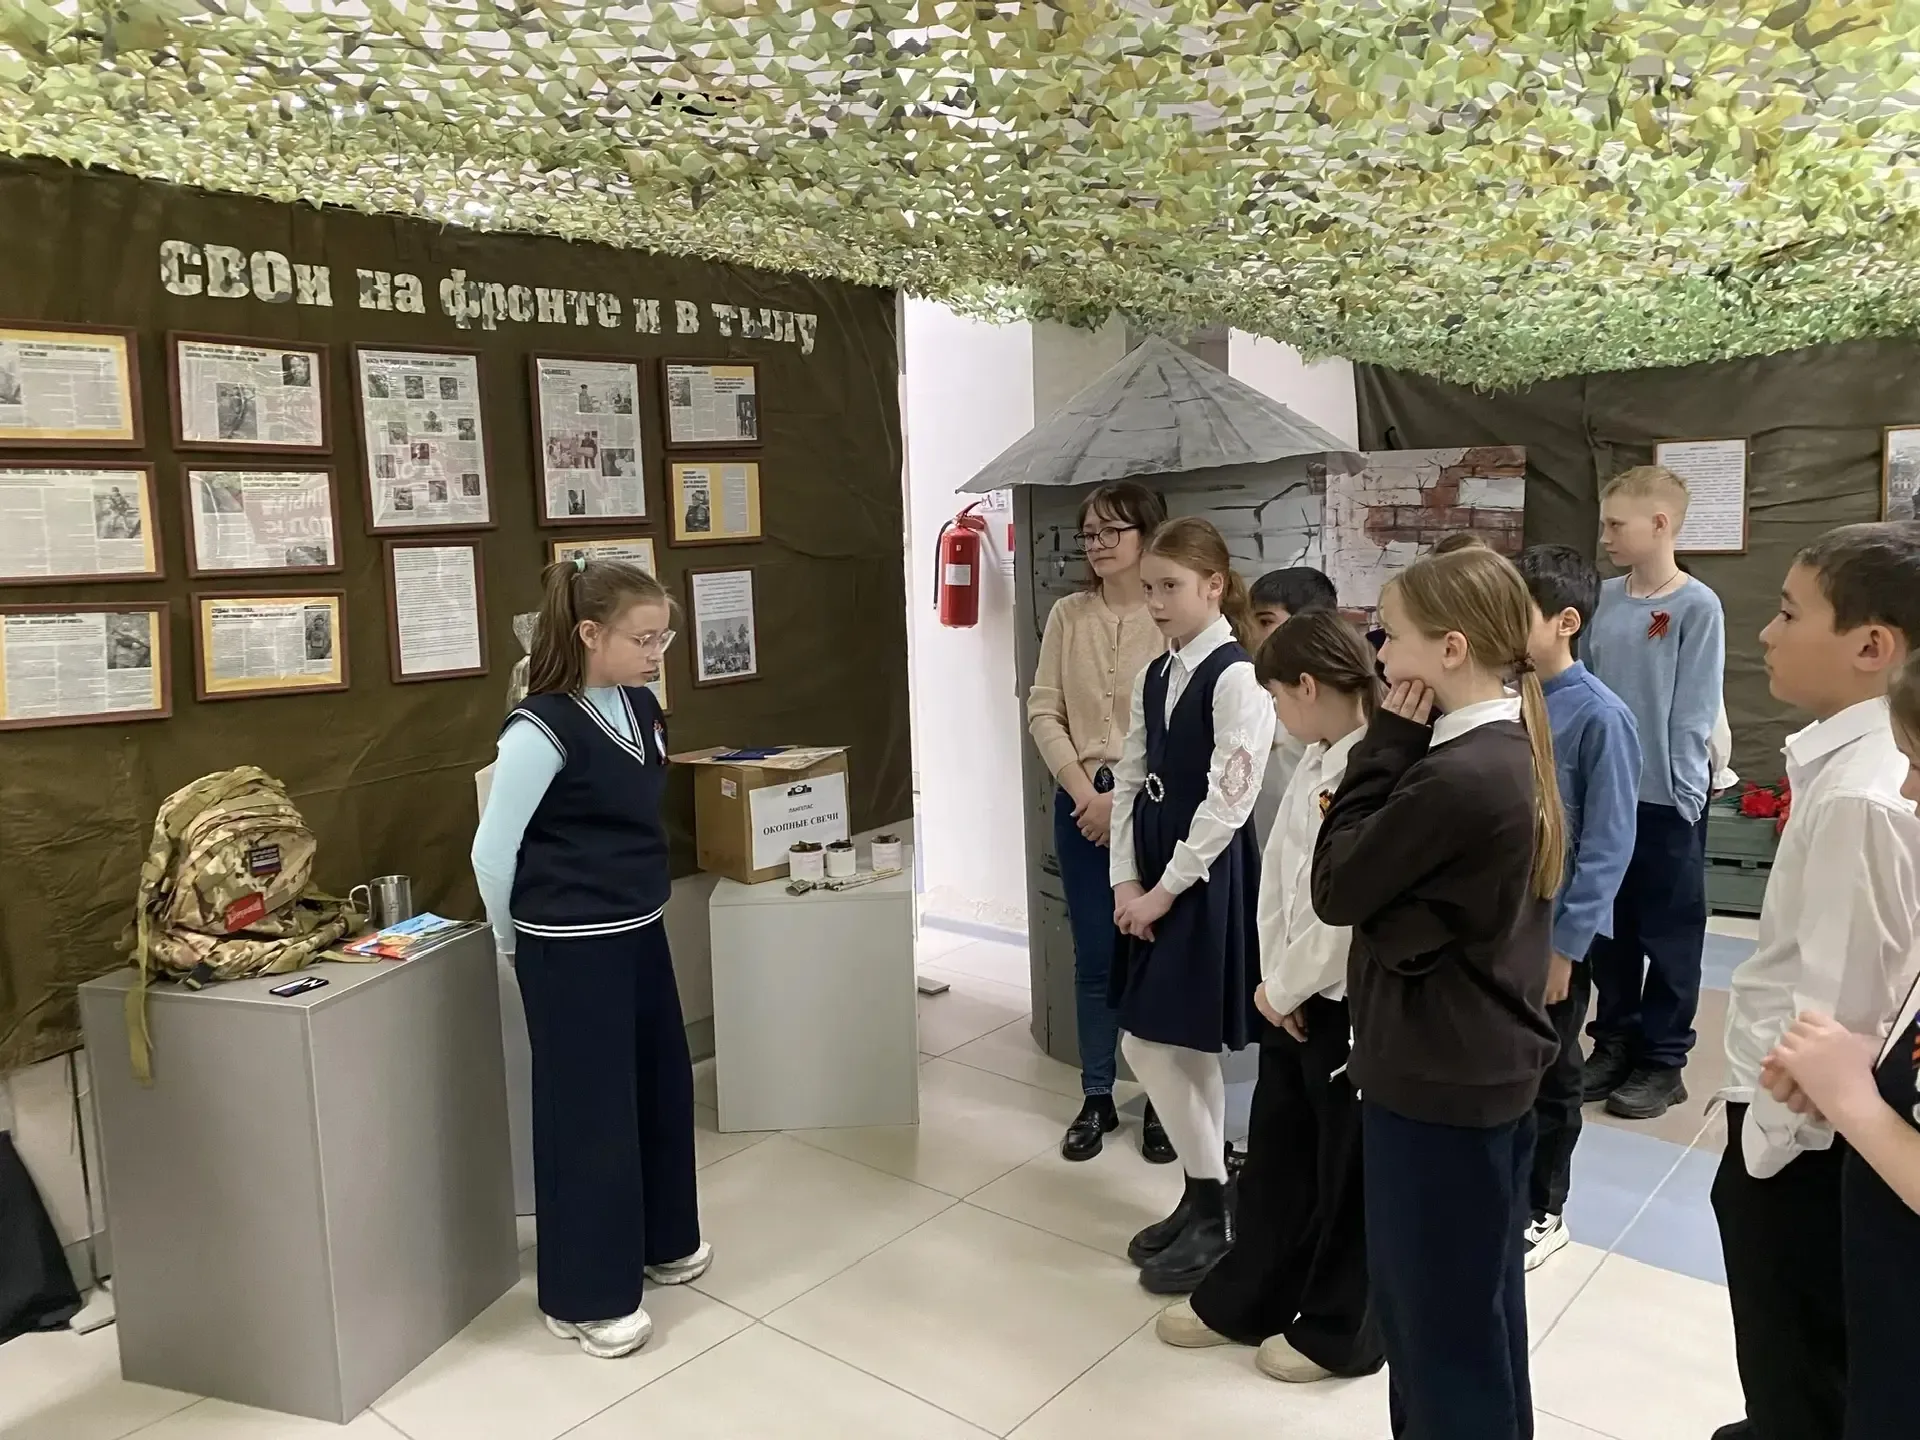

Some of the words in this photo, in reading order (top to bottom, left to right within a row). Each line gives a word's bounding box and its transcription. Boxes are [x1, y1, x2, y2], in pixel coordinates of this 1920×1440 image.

[356, 267, 426, 314] на
[439, 268, 622, 331] фронте
[632, 298, 662, 334] и
[711, 302, 818, 356] тылу
[763, 819, 809, 836] ОКОПНЫЕ
[810, 812, 839, 826] СВЕЧИ
